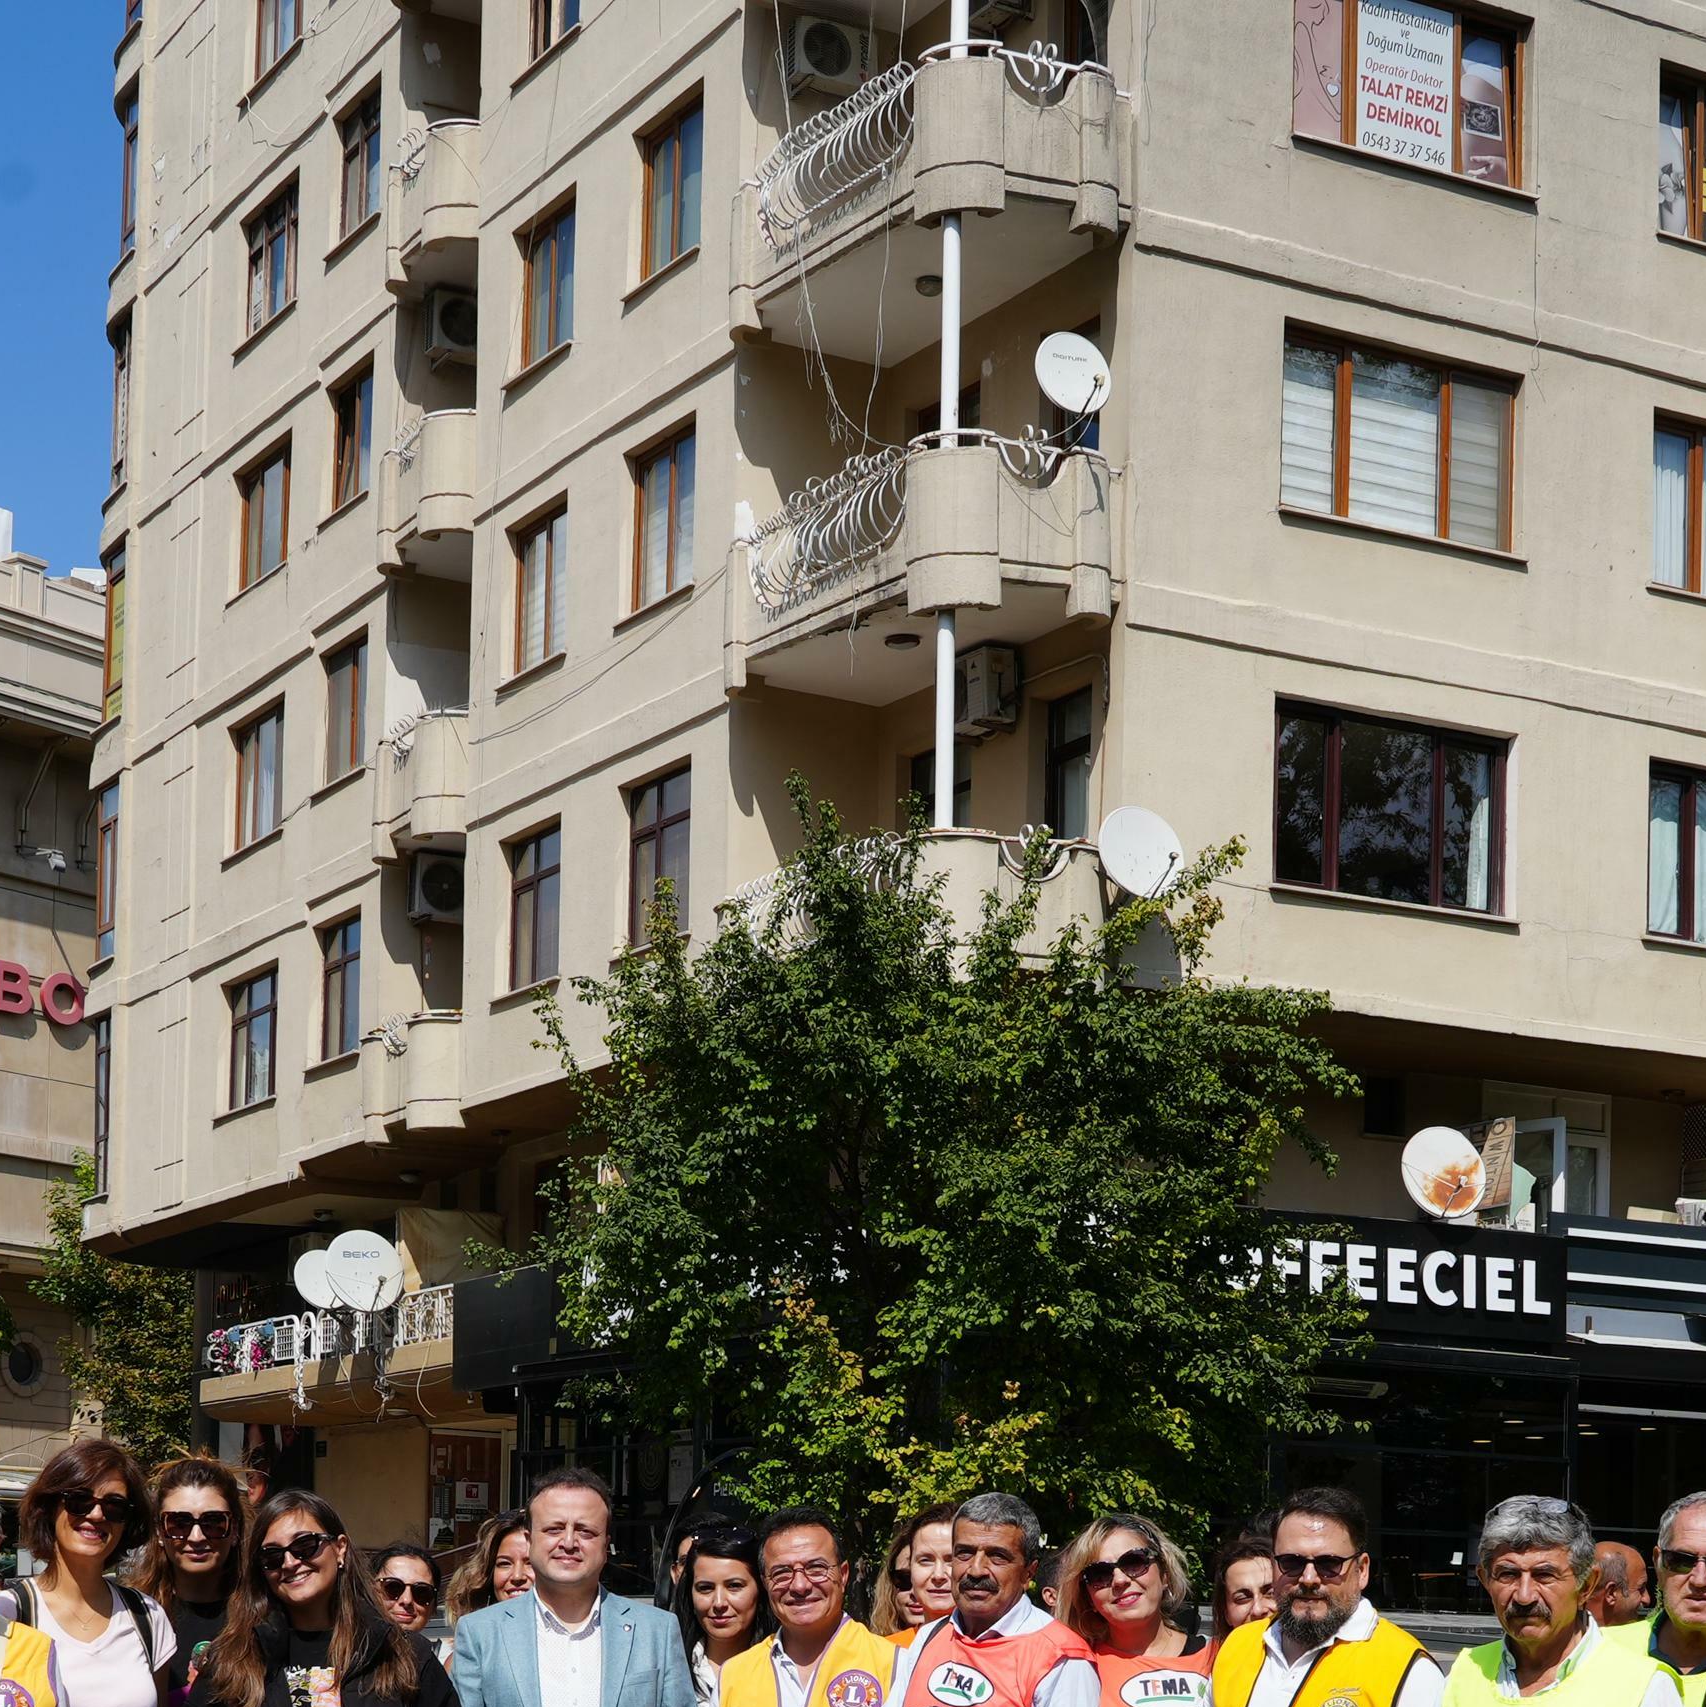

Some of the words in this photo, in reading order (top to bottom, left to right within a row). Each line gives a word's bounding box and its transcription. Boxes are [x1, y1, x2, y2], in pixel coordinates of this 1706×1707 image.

[1361, 0, 1390, 18] Kadın
[1392, 8, 1449, 37] Hastalıkları
[1401, 29, 1411, 39] ve
[1366, 31, 1404, 53] Doğum
[1405, 42, 1444, 65] Uzmanı
[1365, 57, 1408, 79] Operatör
[1410, 69, 1444, 89] Doktor
[1361, 75, 1403, 101] TALAT
[1405, 87, 1448, 114] REMZİ
[1366, 102, 1442, 138] DEMİRKOL
[1362, 131, 1391, 151] 0543
[1393, 139, 1407, 155] 37
[1408, 143, 1422, 160] 37
[1424, 147, 1446, 166] 546
[342, 1250, 381, 1259] BEKO
[844, 1675, 870, 1687] LIONS
[845, 1686, 861, 1703] L
[1139, 1678, 1191, 1697] TEMA
